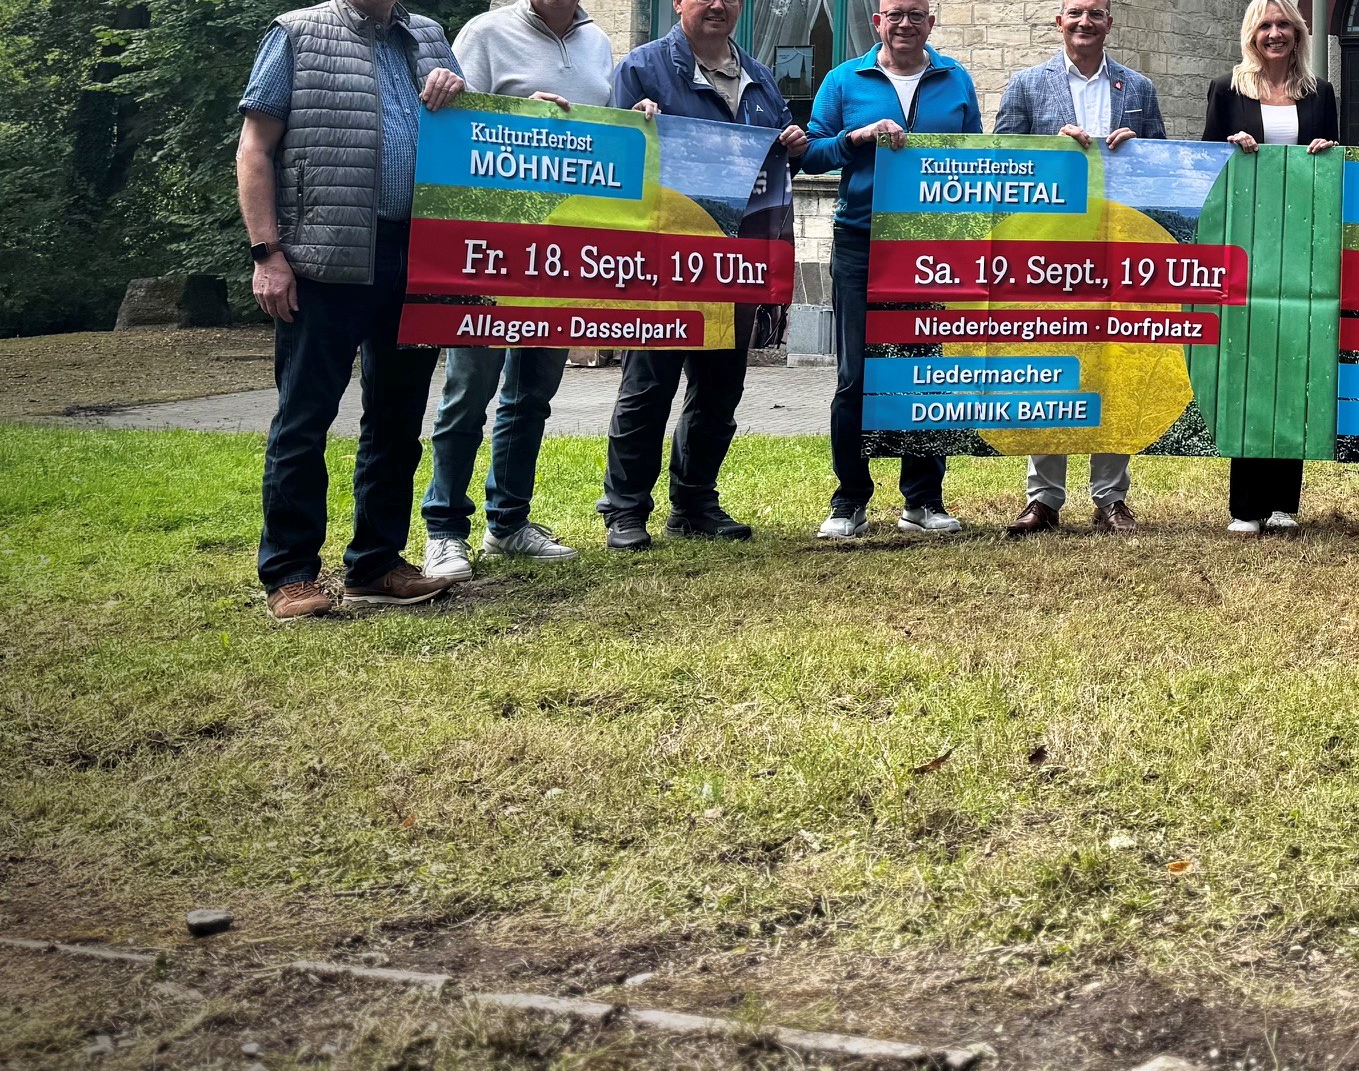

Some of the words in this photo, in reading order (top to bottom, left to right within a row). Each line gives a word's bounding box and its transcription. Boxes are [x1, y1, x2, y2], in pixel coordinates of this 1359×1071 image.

[471, 122, 593, 151] KulturHerbst
[471, 147, 620, 187] MÖHNETAL
[920, 158, 1034, 175] KulturHerbst
[919, 176, 1065, 204] MÖHNETAL
[462, 239, 507, 275] Fr.
[525, 243, 569, 277] 18.
[581, 245, 658, 287] Sept.,
[671, 251, 702, 282] 19
[714, 253, 767, 284] Uhr
[915, 255, 960, 284] Sa.
[975, 255, 1015, 284] 19.
[1027, 258, 1107, 290] Sept.,
[1121, 261, 1155, 286] 19
[1166, 261, 1226, 288] Uhr
[457, 314, 549, 343] Allagen
[570, 317, 687, 343] Dasselpark
[915, 317, 1088, 339] Niederbergheim
[1107, 317, 1202, 339] Dorfplatz
[913, 365, 1062, 384] Liedermacher
[912, 403, 1010, 422] DOMINIK
[1018, 401, 1087, 420] BATHE
